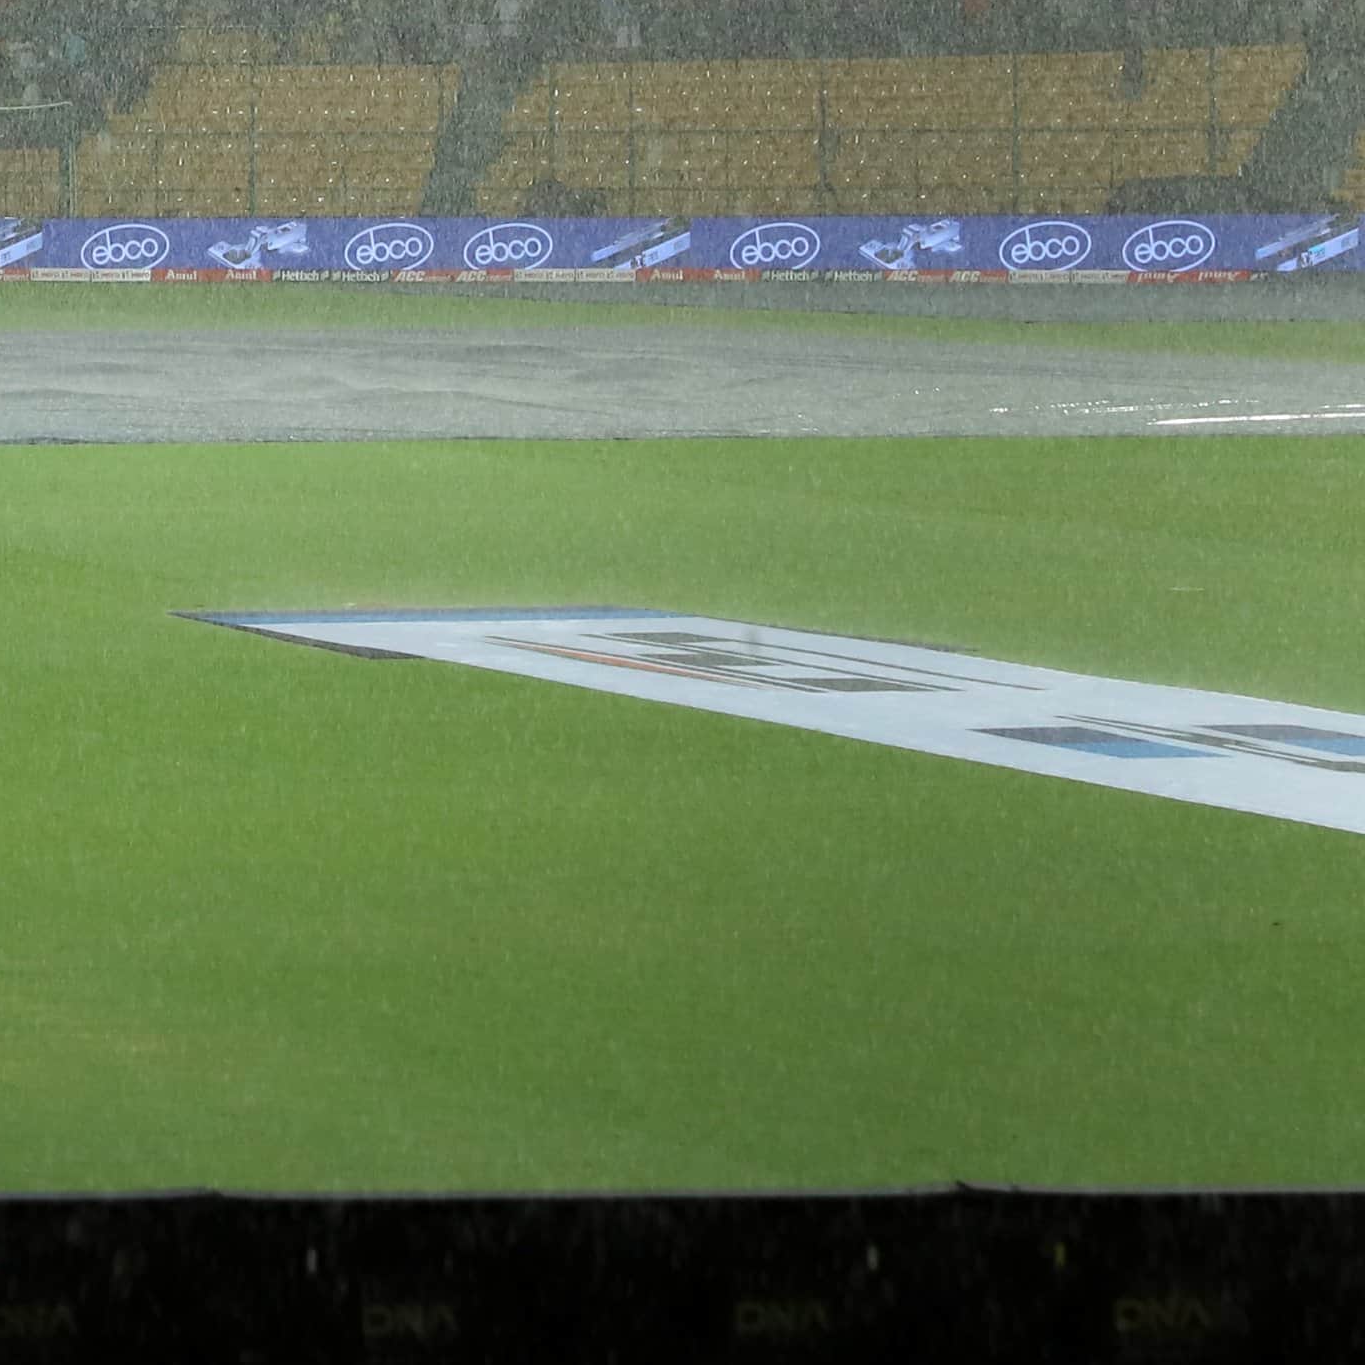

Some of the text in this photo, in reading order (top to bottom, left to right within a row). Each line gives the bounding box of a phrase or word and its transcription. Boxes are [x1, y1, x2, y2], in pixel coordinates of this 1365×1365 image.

[91, 225, 157, 264] ebco
[356, 225, 423, 264] ebco
[476, 225, 540, 263] ebco
[741, 224, 808, 263] ebco
[1011, 224, 1078, 263] ebco
[1135, 223, 1202, 263] ebco
[394, 271, 425, 281] ACC
[454, 271, 486, 281] ACC
[887, 271, 918, 281] ACC
[949, 271, 980, 281] ACC
